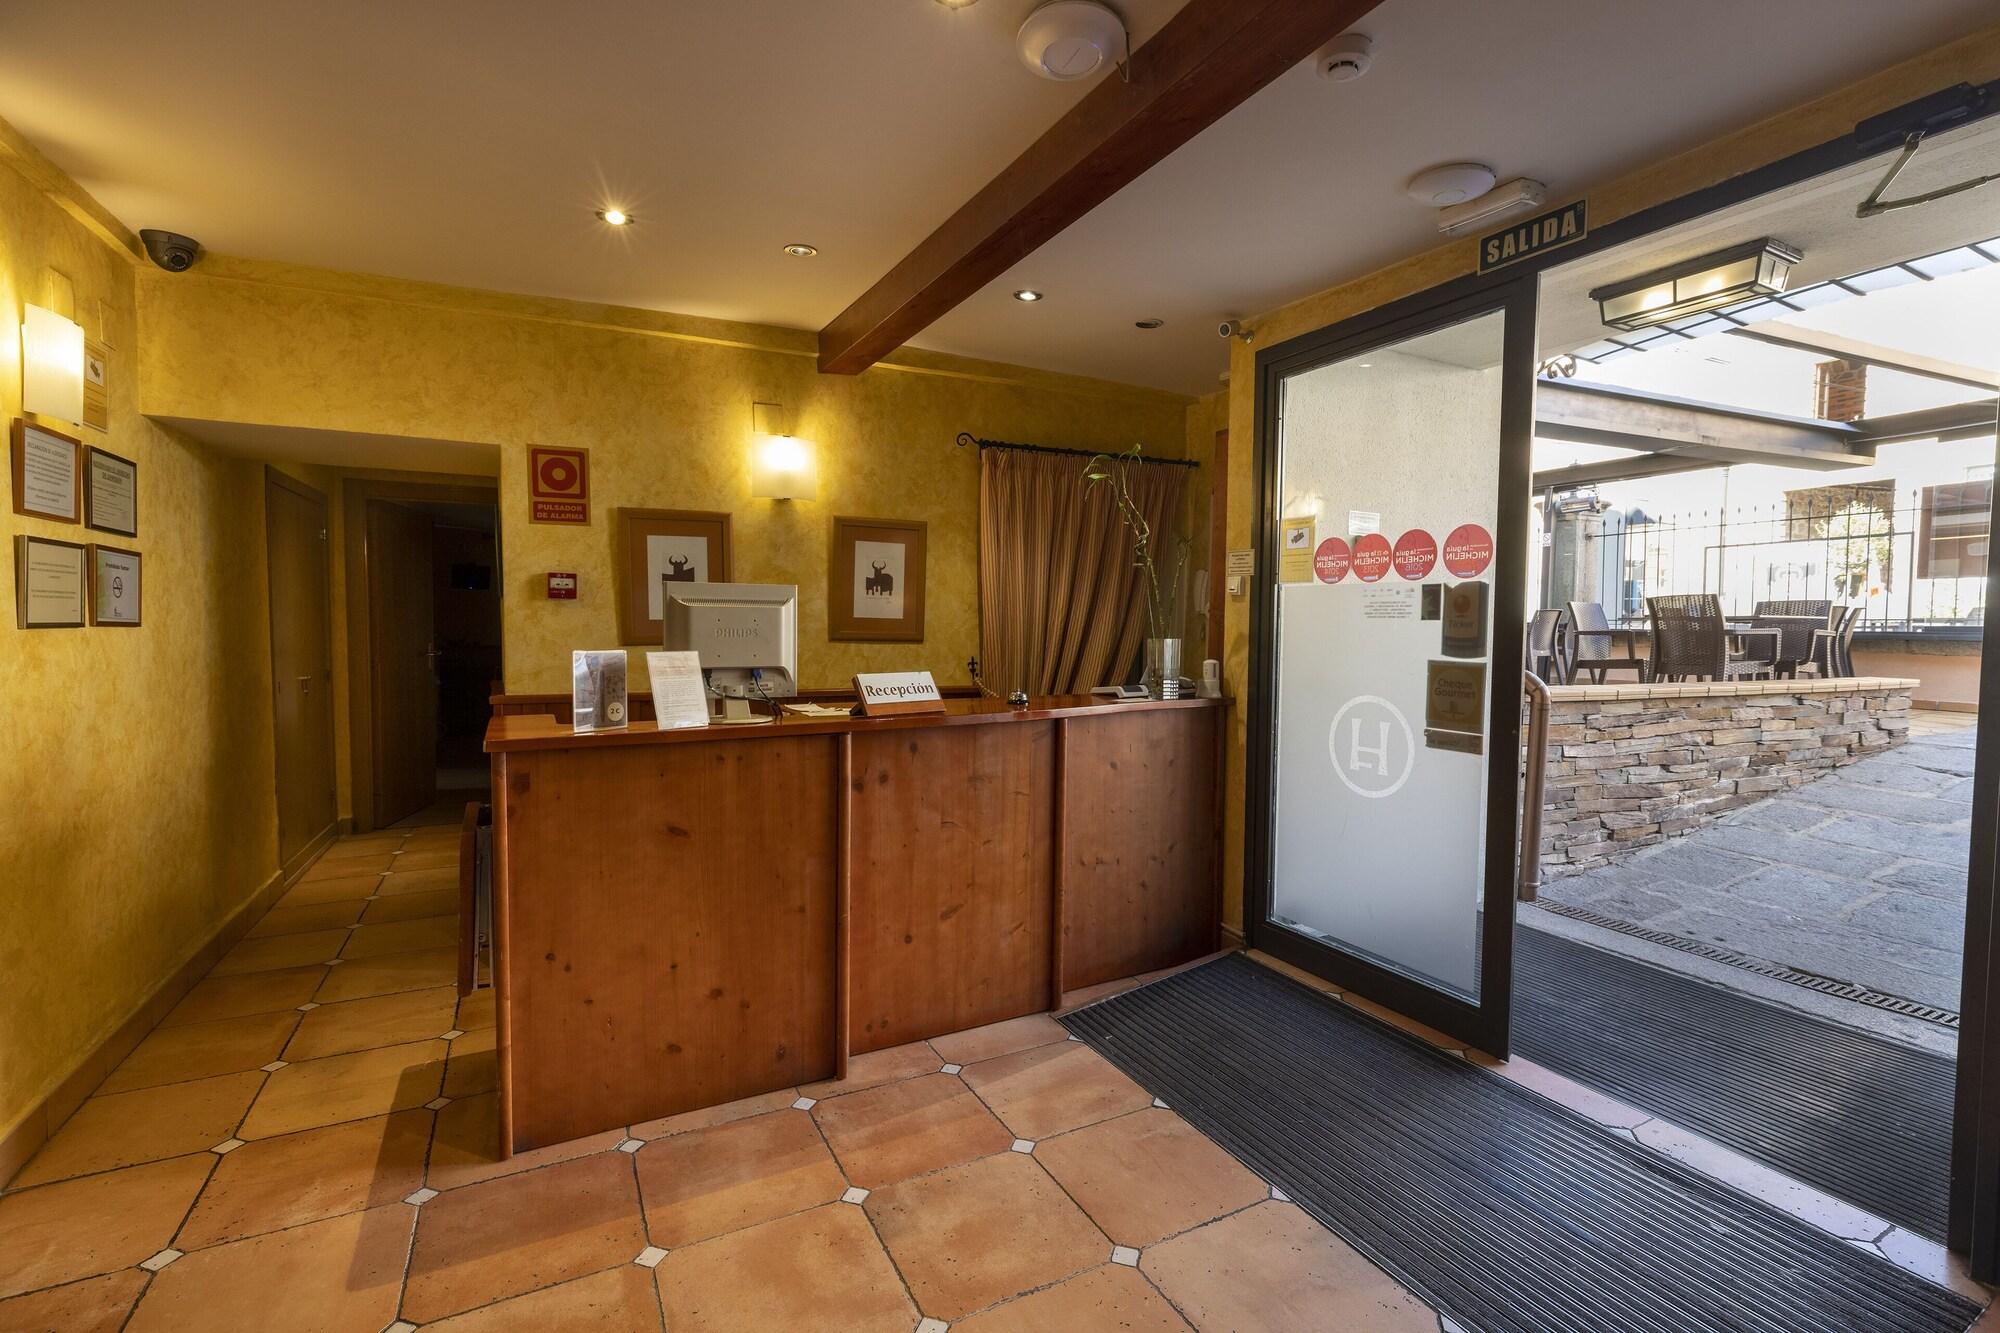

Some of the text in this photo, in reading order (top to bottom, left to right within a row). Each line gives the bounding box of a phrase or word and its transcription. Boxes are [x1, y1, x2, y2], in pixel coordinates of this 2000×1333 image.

[1487, 210, 1577, 263] SALIDA
[537, 503, 583, 512] PULSADOR
[715, 628, 759, 639] PHILIPS
[864, 682, 935, 698] Recepción
